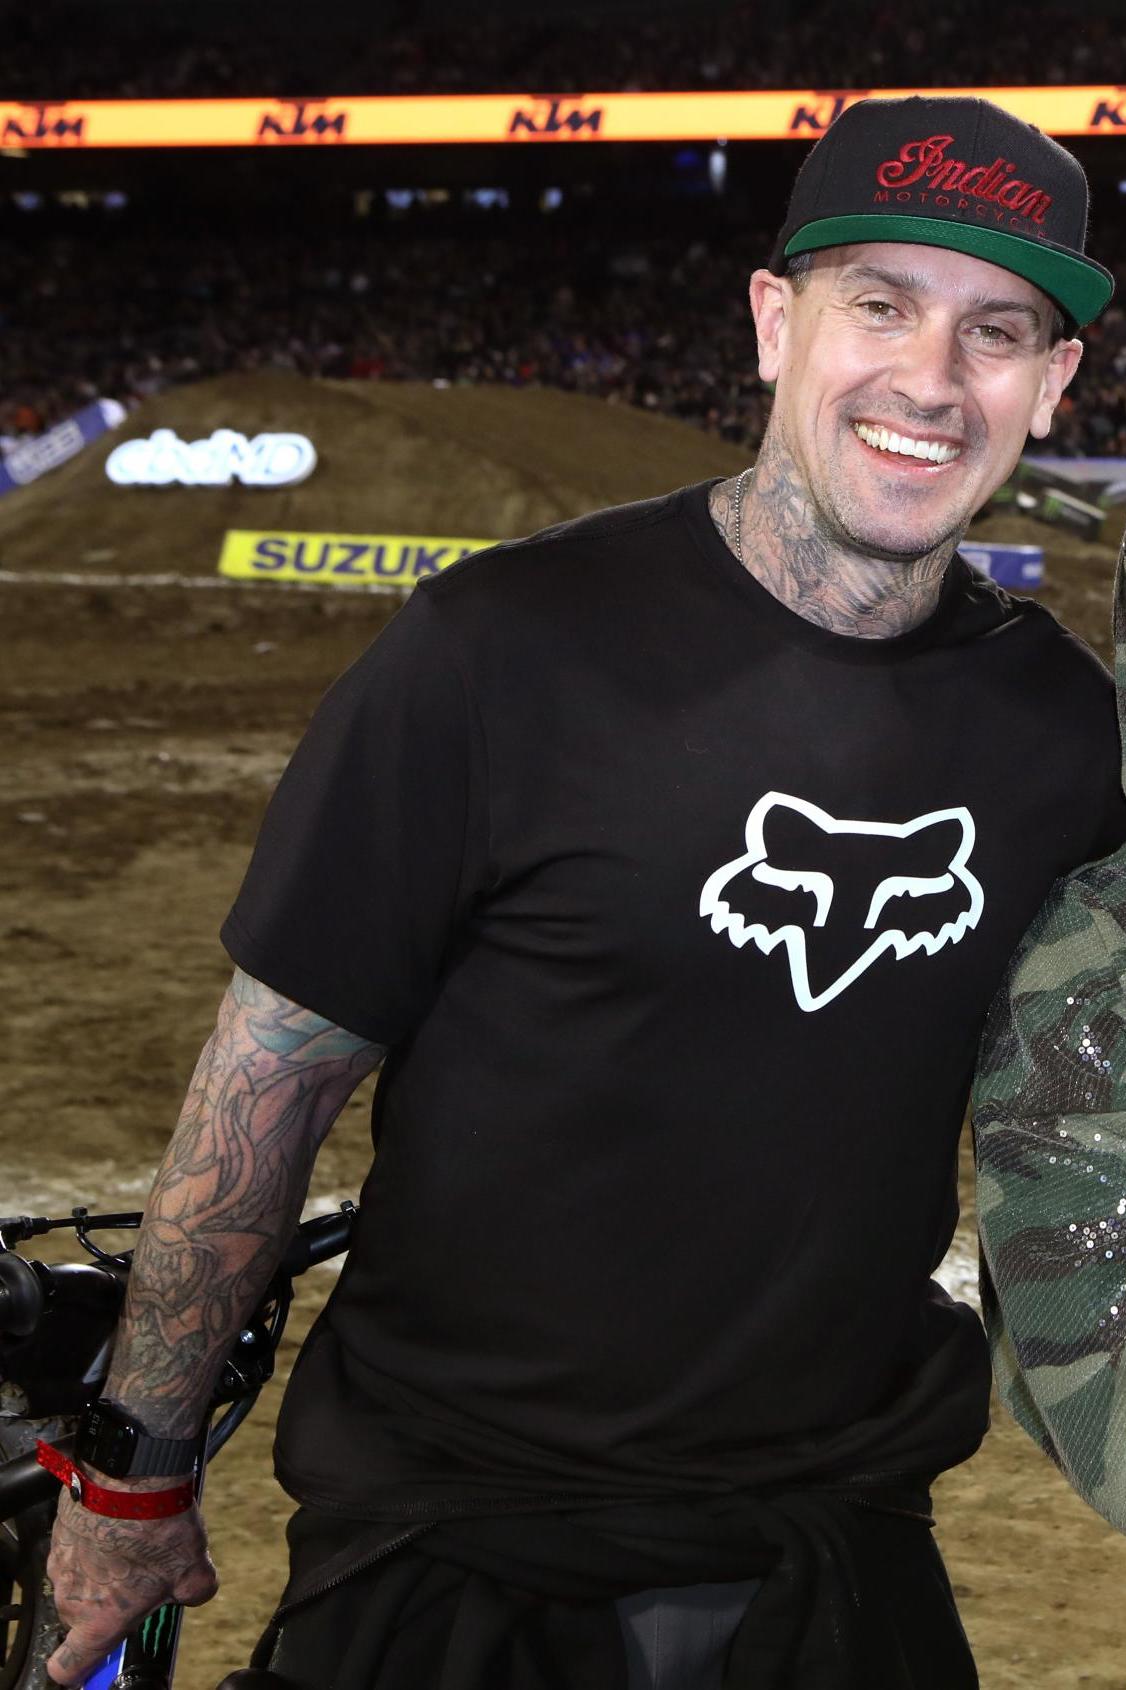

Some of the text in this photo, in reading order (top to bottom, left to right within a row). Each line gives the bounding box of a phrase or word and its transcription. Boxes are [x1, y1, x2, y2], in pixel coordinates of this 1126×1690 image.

[258, 98, 346, 136] KTM
[510, 94, 601, 132] KTM
[789, 91, 862, 131] KT
[876, 134, 1053, 225] Indian
[252, 539, 473, 578] SUZUK
